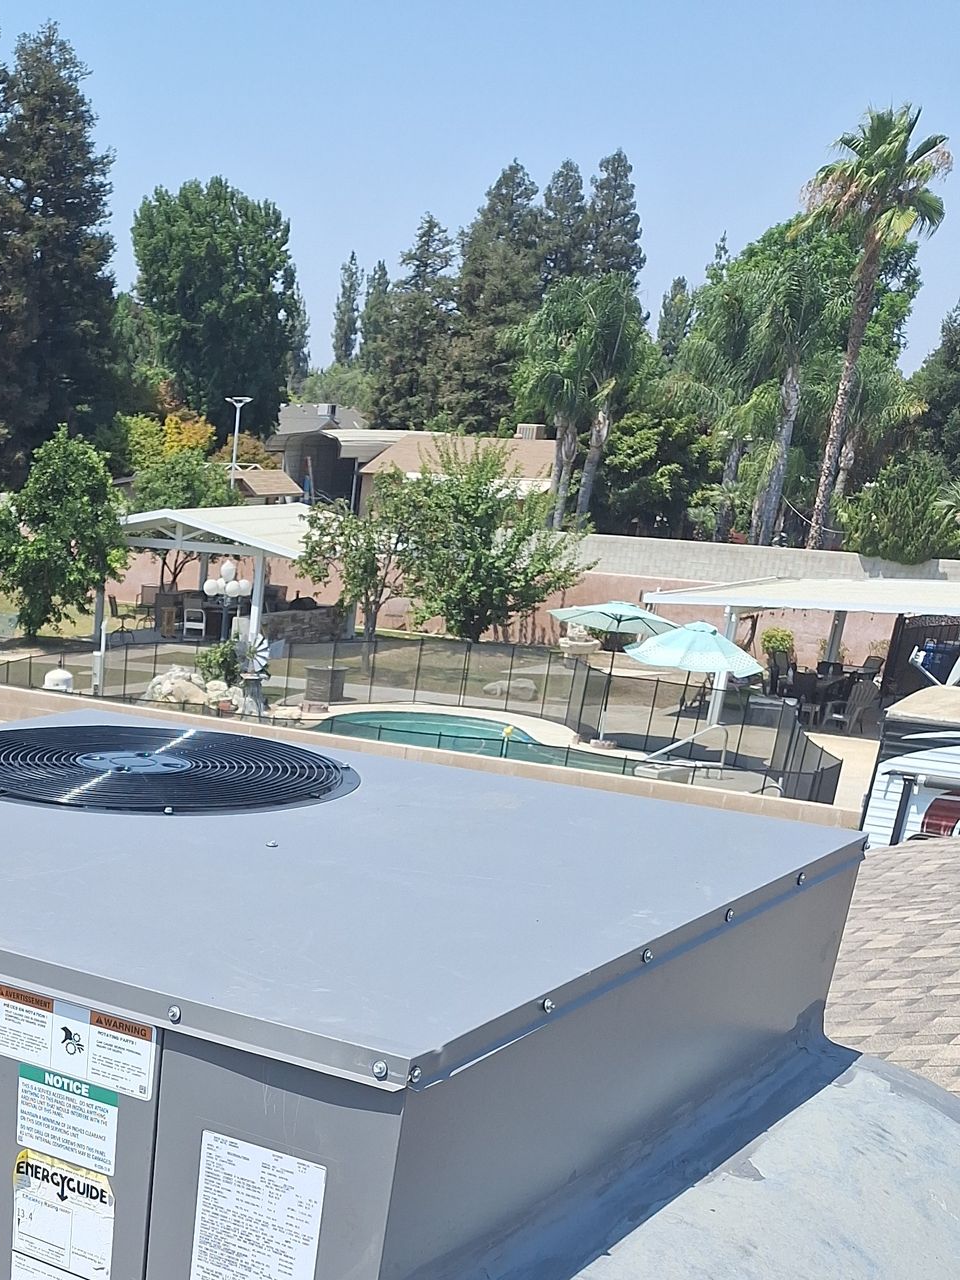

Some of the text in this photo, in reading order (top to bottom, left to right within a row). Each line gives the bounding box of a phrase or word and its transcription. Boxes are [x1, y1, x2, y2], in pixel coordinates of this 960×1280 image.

[5, 990, 50, 1008] AVERTISSEMENT
[104, 1019, 146, 1037] WARNING
[44, 1072, 90, 1096] NOTICE
[16, 1161, 107, 1204] ENERGYGUIDE
[17, 1208, 33, 1222] 13.4
